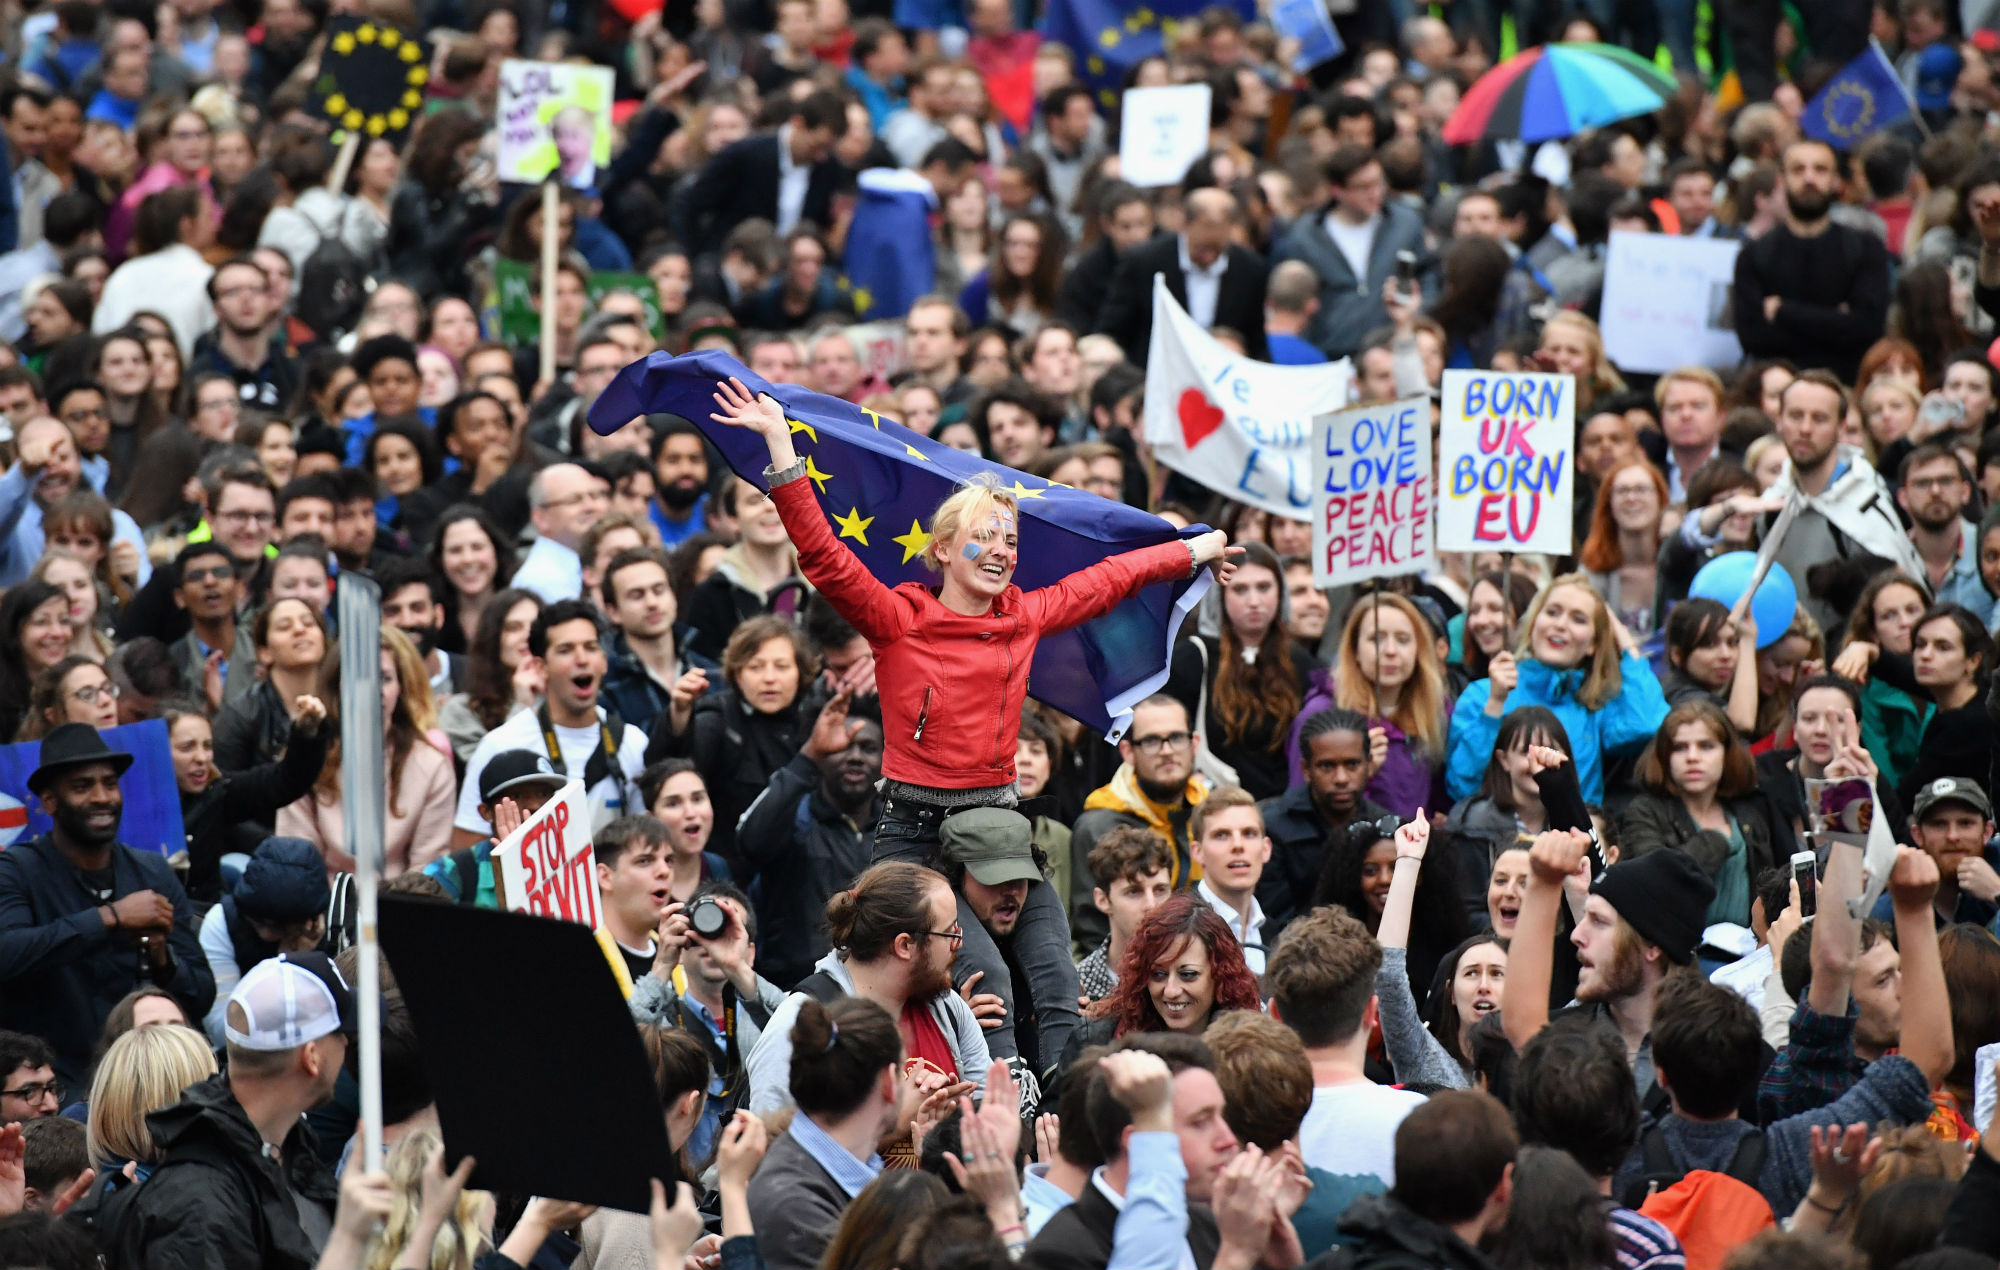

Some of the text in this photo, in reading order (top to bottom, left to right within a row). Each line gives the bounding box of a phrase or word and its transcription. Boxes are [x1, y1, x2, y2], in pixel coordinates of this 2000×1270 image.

[1462, 378, 1564, 421] BORN
[1326, 408, 1417, 457] LOVE
[1478, 417, 1538, 458] UK
[1324, 446, 1418, 494] LOVE
[1450, 450, 1566, 499] BORN
[1326, 475, 1429, 535] PEACE
[1472, 490, 1542, 543] EU
[1326, 517, 1426, 575] PEACE
[520, 800, 569, 895] STOP
